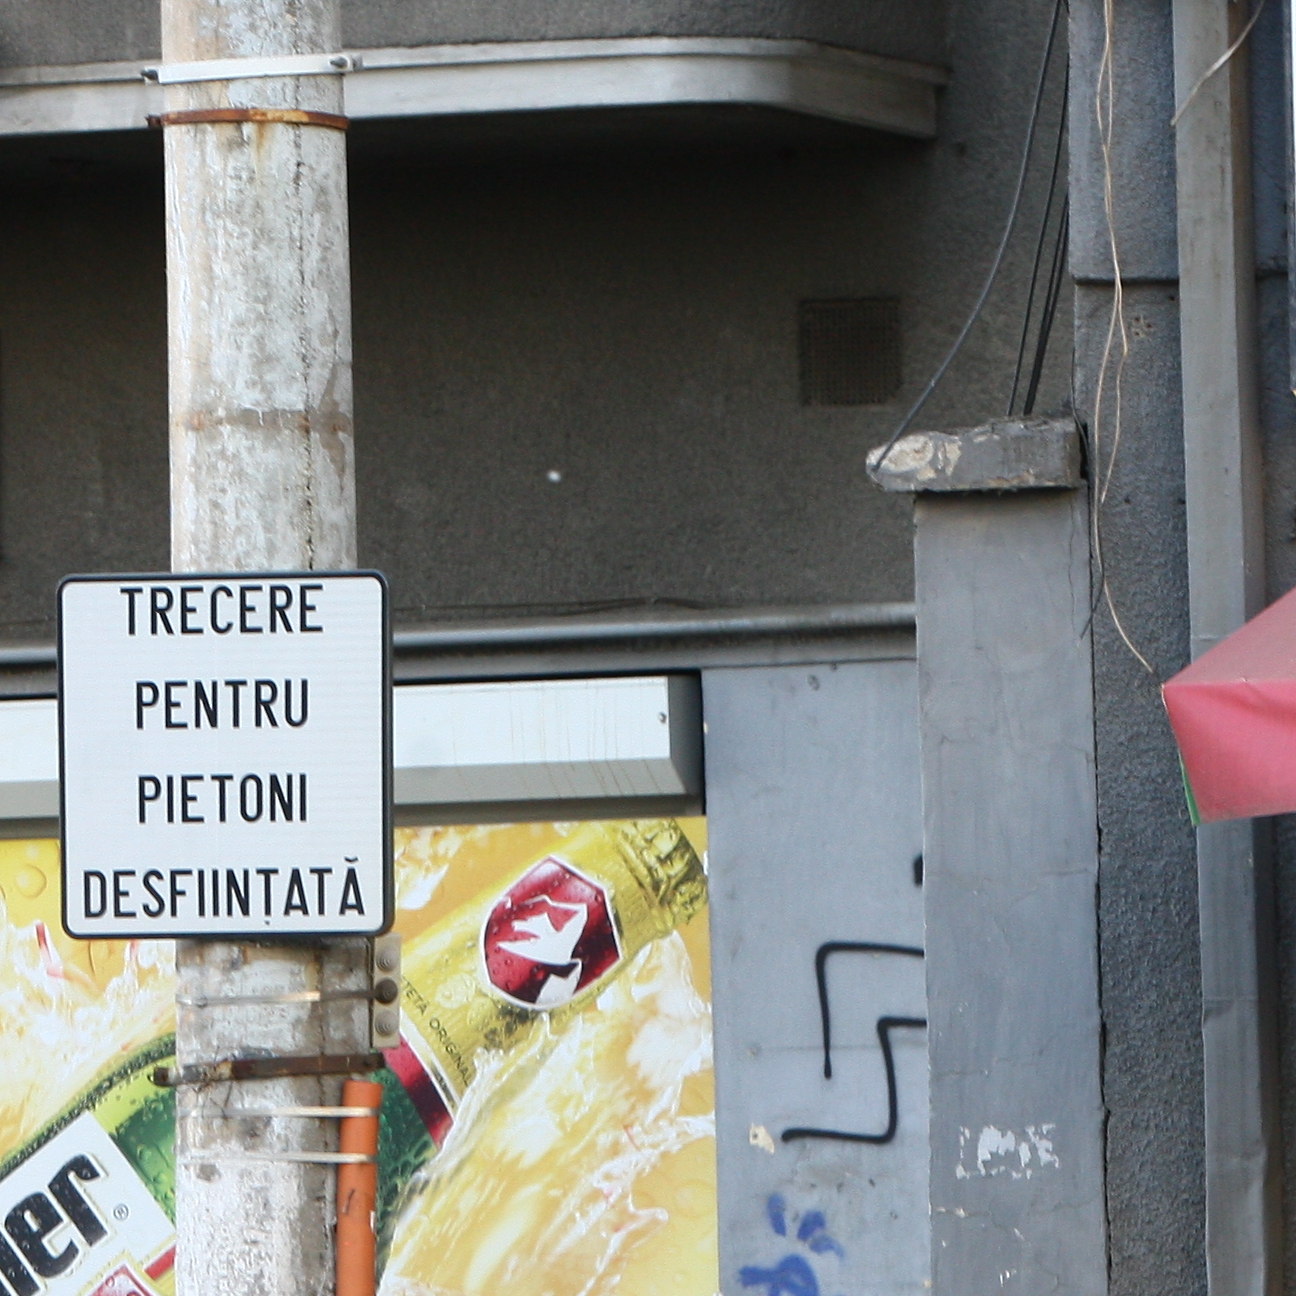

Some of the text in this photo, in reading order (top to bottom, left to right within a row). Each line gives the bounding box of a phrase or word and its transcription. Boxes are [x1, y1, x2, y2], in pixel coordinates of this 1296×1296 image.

[120, 583, 324, 635] TRECERE
[136, 680, 308, 729] PENTRU
[138, 774, 307, 822] PIETONI
